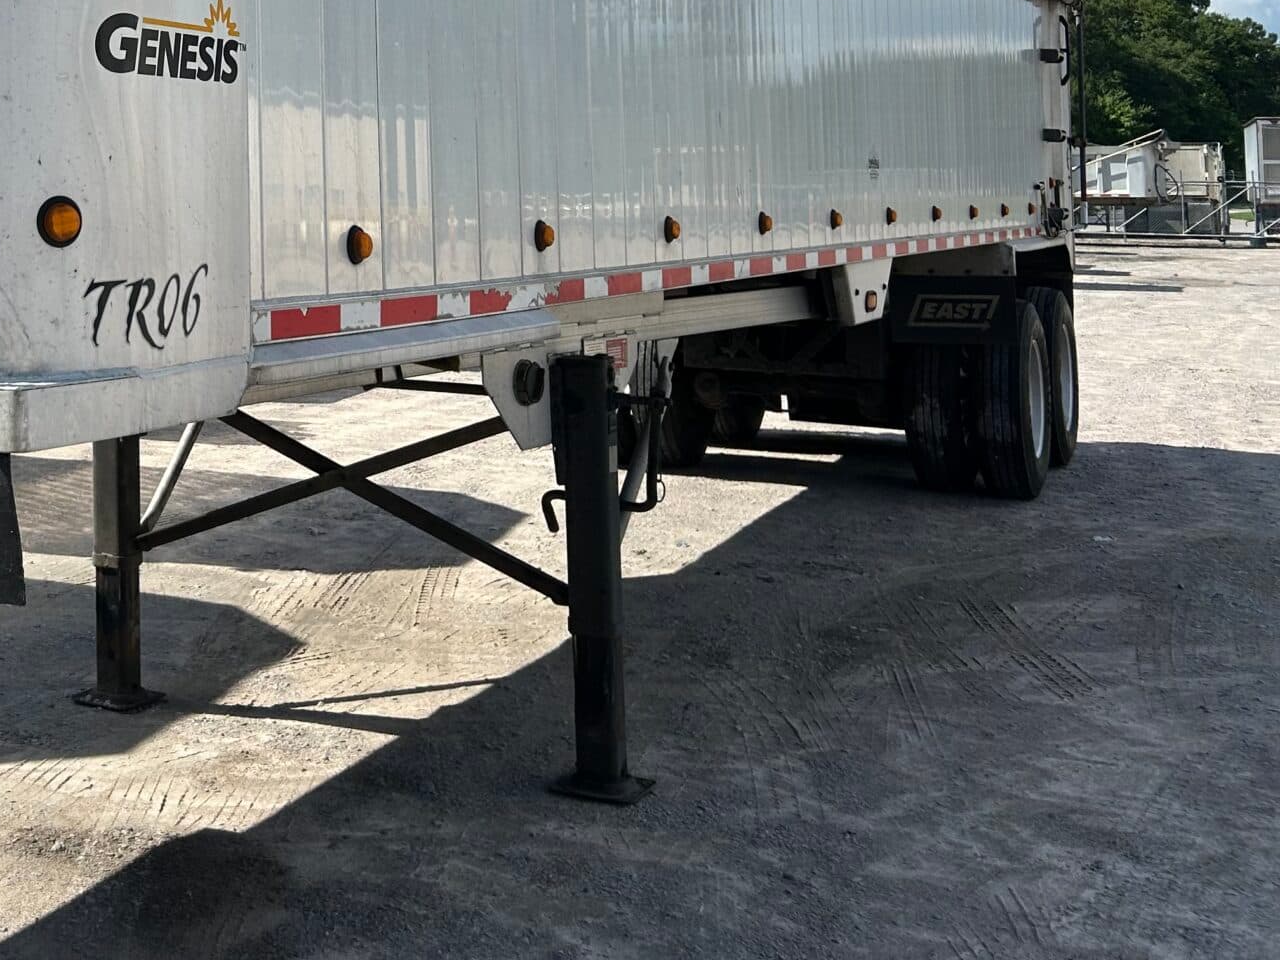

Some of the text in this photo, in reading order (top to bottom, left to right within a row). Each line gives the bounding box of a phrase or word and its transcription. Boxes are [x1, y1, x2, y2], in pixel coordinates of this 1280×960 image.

[95, 12, 239, 84] GENESIS
[83, 263, 209, 350] TR06
[920, 302, 988, 320] EAST
